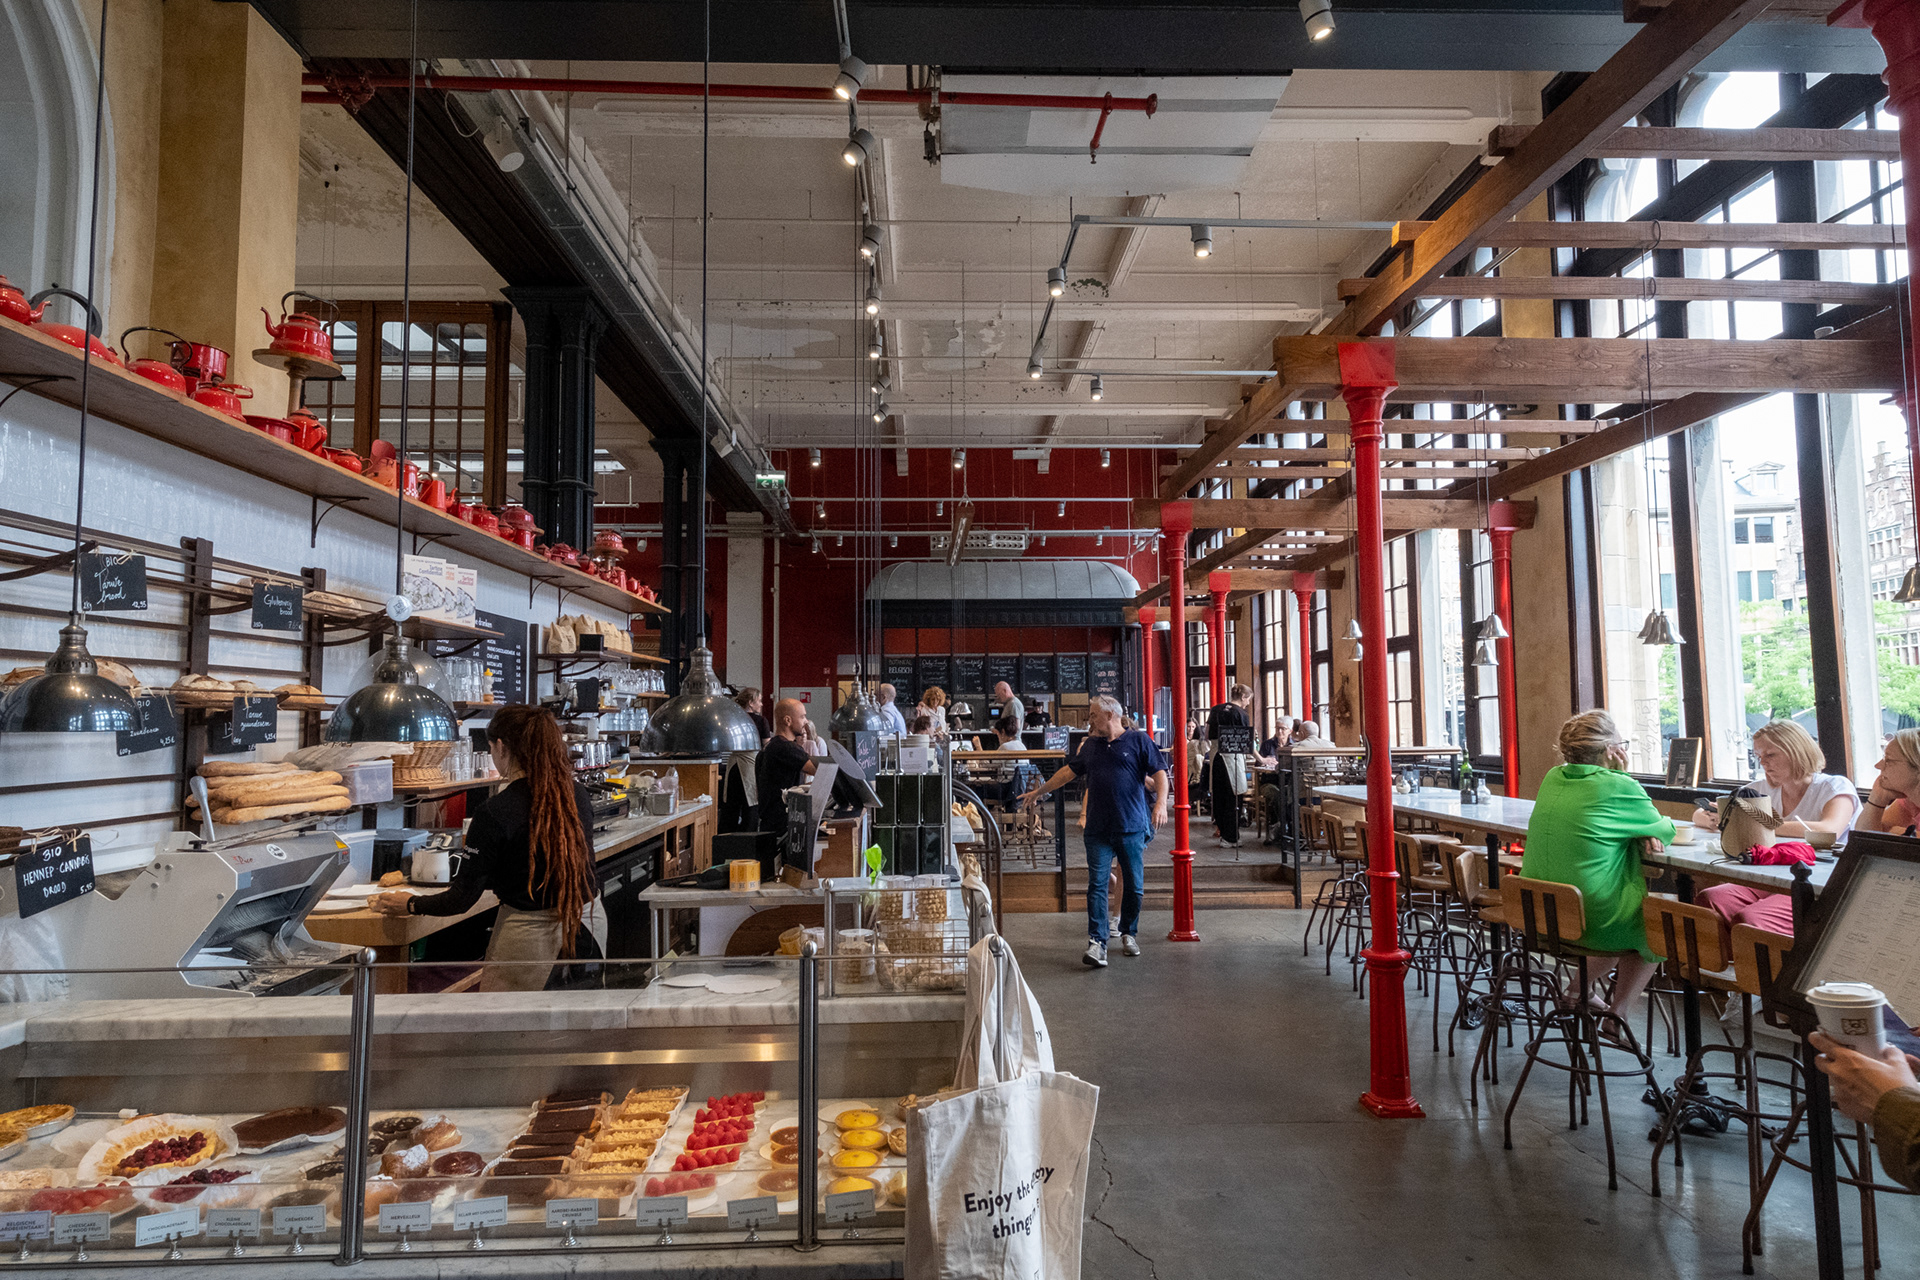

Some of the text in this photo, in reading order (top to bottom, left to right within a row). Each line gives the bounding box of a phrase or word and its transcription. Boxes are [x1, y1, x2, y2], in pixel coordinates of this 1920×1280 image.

[106, 557, 118, 567] BIO
[94, 567, 123, 592] Tarwe
[97, 587, 126, 605] brood
[137, 700, 150, 708] BIO
[964, 1190, 1012, 1217] Enjoy
[1017, 1180, 1031, 1200] the
[992, 1215, 1032, 1239] things
